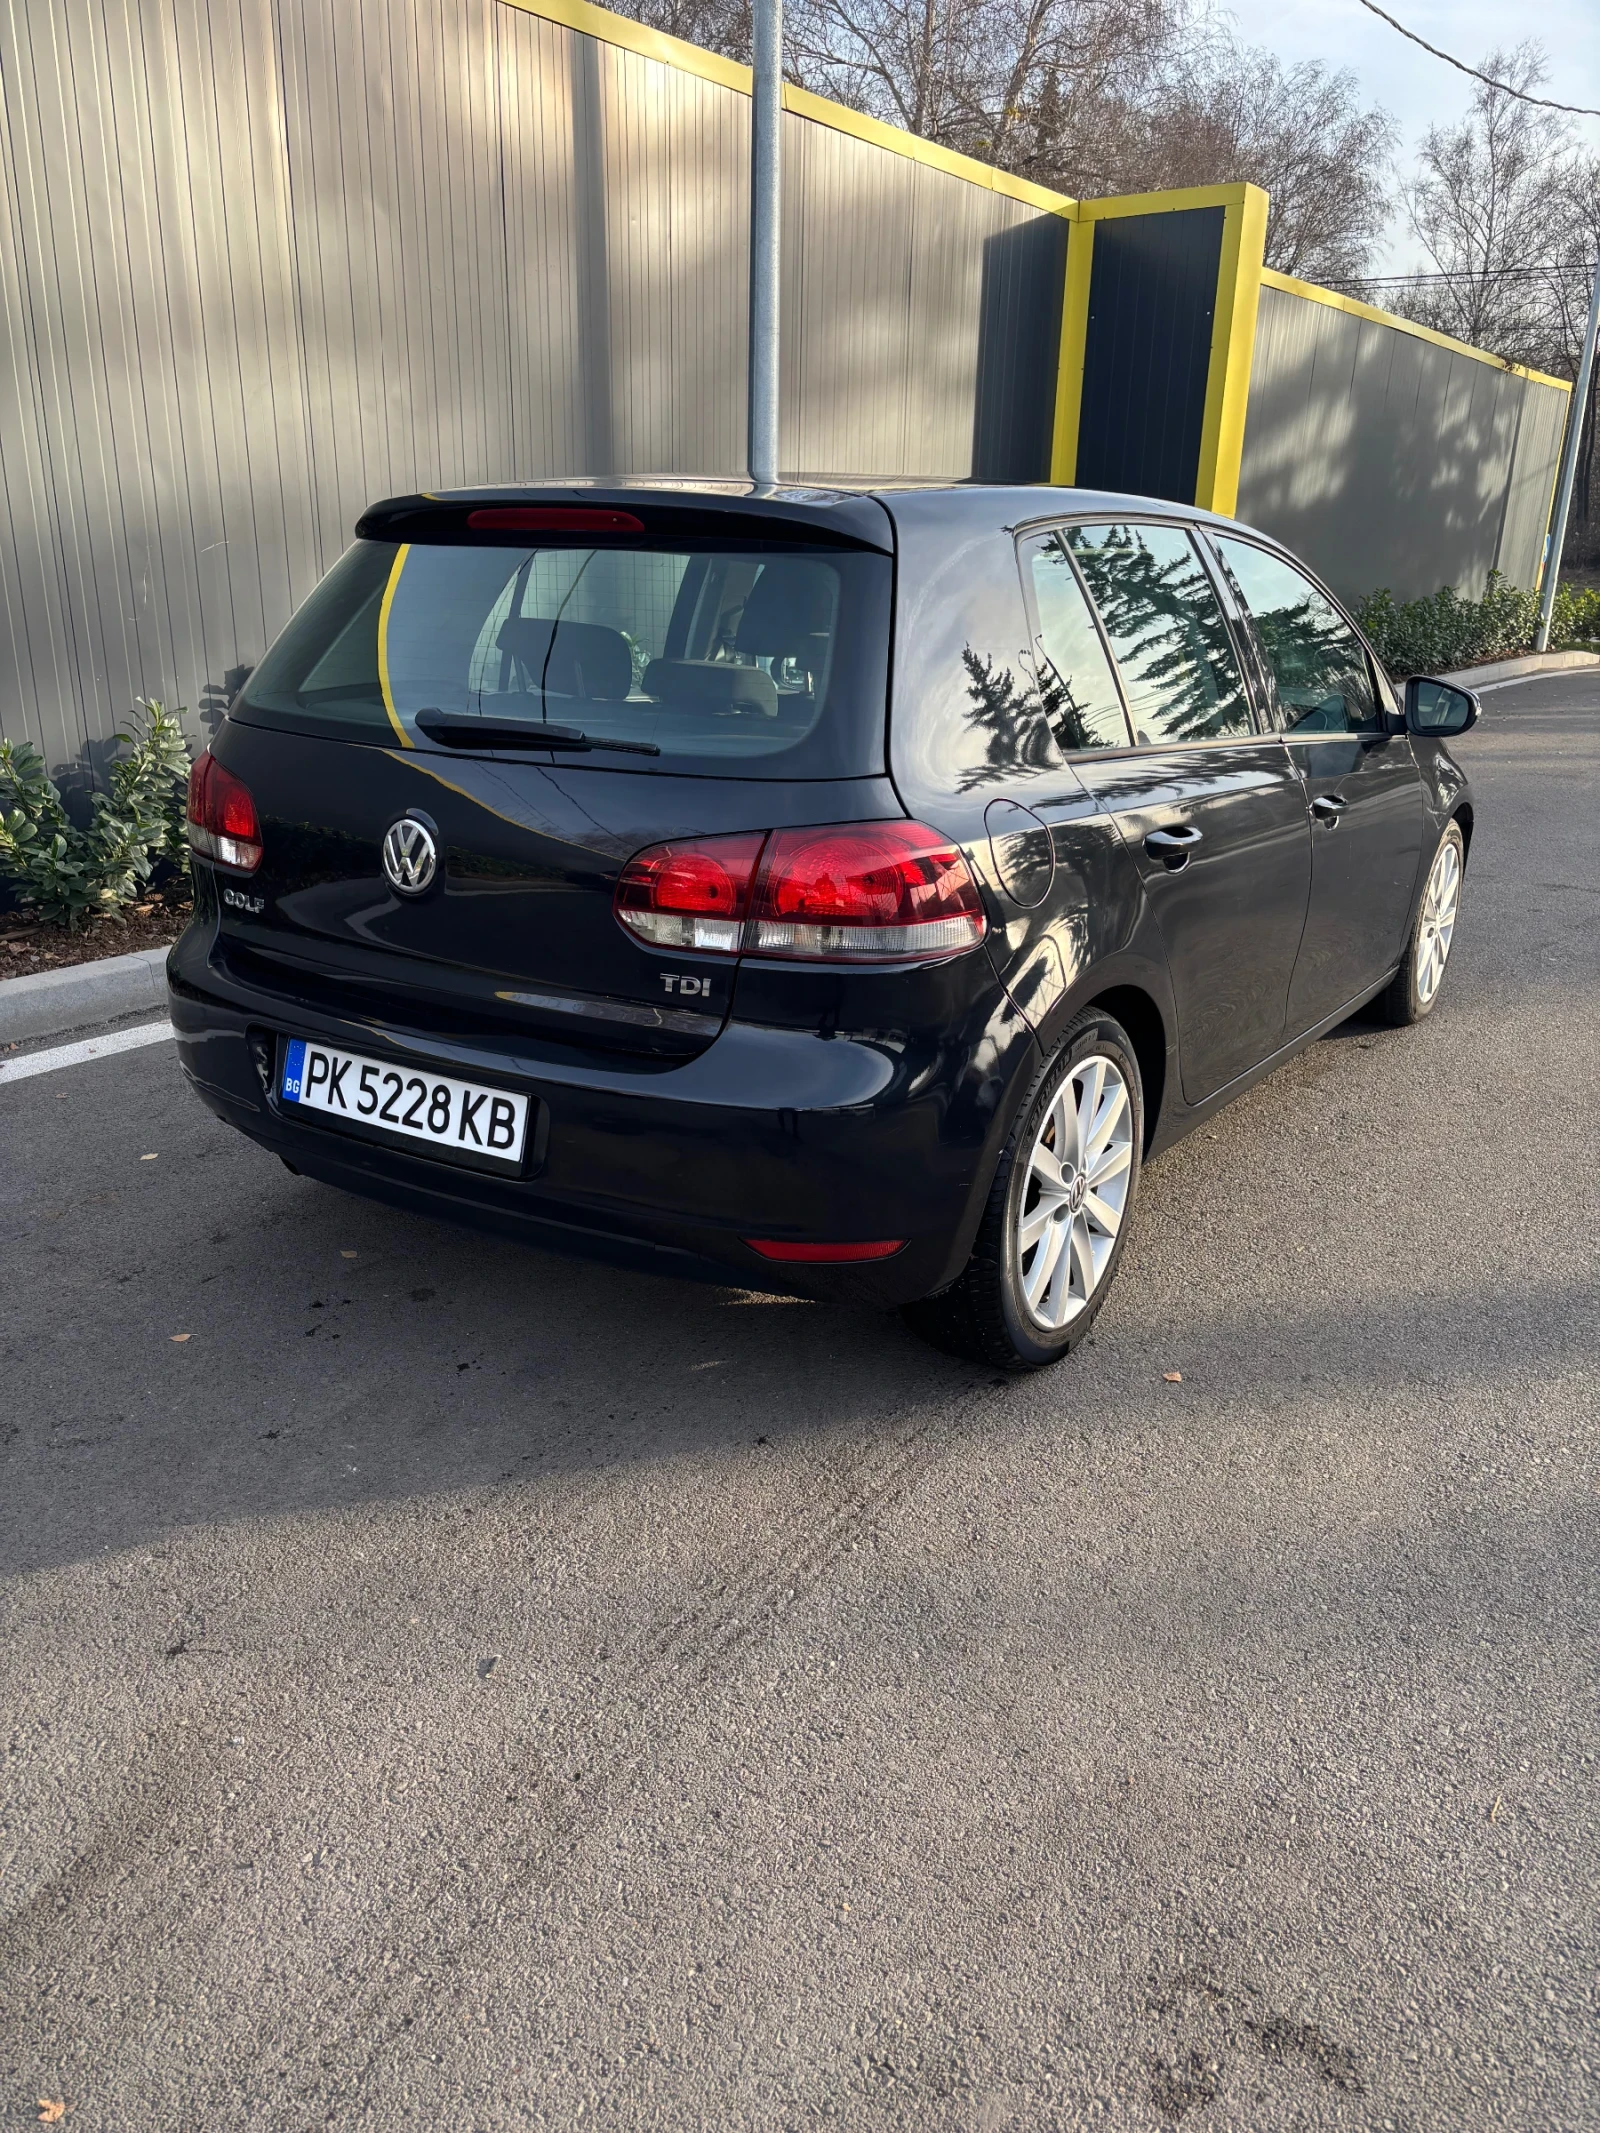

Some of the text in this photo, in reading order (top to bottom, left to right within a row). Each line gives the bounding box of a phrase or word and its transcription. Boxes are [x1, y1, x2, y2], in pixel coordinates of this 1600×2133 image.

[383, 819, 436, 893] VW
[223, 888, 265, 913] GOLF
[660, 973, 711, 997] TDI
[285, 1077, 300, 1094] BG
[305, 1051, 516, 1150] PK 5228 KB
